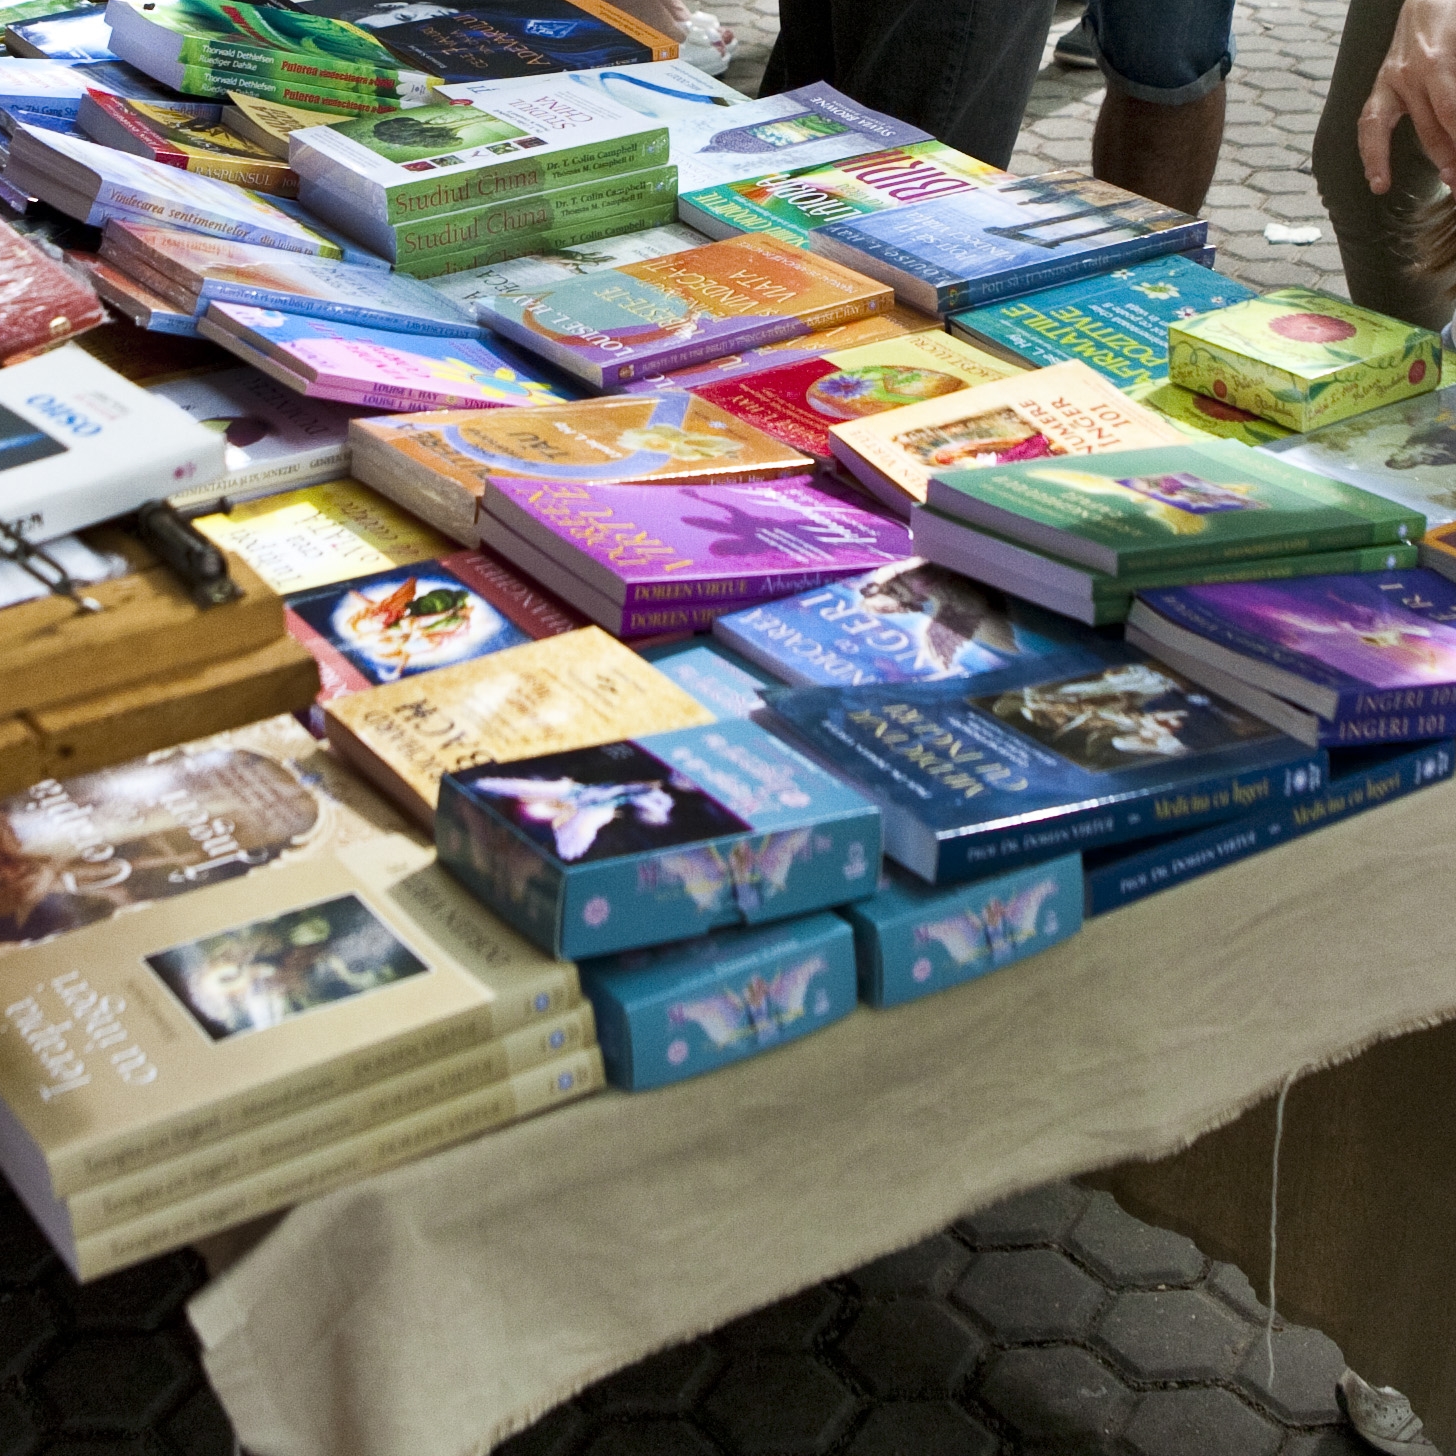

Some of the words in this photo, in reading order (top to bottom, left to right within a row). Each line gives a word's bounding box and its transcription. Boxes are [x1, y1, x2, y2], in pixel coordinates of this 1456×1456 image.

[199, 55, 231, 69] Ruediger
[232, 59, 258, 71] Dahlke
[201, 45, 235, 60] Thorwald
[236, 49, 275, 63] Dethlefsen
[280, 60, 318, 76] Puterea
[203, 73, 237, 86] Thorwald
[238, 77, 276, 92] Dethlefsen
[282, 89, 320, 104] Puterea
[40, 104, 63, 117] Gang
[507, 96, 578, 130] STUDIUL
[532, 93, 597, 123] CHINA
[809, 94, 862, 123] BROWNE
[852, 116, 897, 139] SYLVIA
[194, 165, 272, 185] RĂSPUNSUL
[395, 177, 470, 215] Studiul
[476, 169, 539, 197] China
[546, 159, 560, 171] Dr.
[562, 157, 571, 167] T.
[573, 151, 594, 165] Colin
[594, 142, 638, 162] Campbell
[551, 167, 581, 179] Thomas
[582, 165, 591, 174] M.
[591, 156, 626, 172] Campbell
[560, 205, 589, 217] Thomas
[590, 203, 600, 212] M.
[601, 193, 635, 209] Campbell
[685, 191, 785, 229] CHOQUETTE
[735, 173, 874, 223] LĂTORIA
[108, 187, 165, 215] Vindecarea
[259, 233, 276, 246] din
[403, 217, 478, 255] Studiul
[485, 206, 548, 235] China
[555, 198, 569, 210] Dr.
[570, 196, 579, 206] T.
[581, 189, 603, 204] Colin
[605, 180, 647, 198] Campbell
[580, 228, 603, 244] Colin
[604, 218, 645, 238] Campbell
[504, 292, 560, 314] HAY
[555, 319, 638, 357] LOUISE
[1001, 332, 1036, 348] Hay
[1046, 304, 1171, 369] POZITIVE
[363, 394, 395, 408] LOUISE
[407, 402, 428, 412] HAY
[373, 382, 405, 395] LOUISE
[418, 391, 439, 401] HAY
[15, 391, 114, 440] OSHO
[1003, 399, 1112, 455] NUMERE
[1081, 402, 1137, 427] 101
[634, 580, 693, 600] DOREEN
[696, 580, 746, 596] VIRTUE
[631, 608, 687, 628] DOREEN
[734, 600, 882, 688] NDECAREA
[386, 697, 499, 774] BACH
[1417, 713, 1444, 732] 101
[1071, 818, 1114, 840] VIRTUE
[1154, 793, 1211, 818] Medicina
[1212, 791, 1230, 806] cu
[1216, 831, 1256, 857] VIRTUE
[1292, 794, 1346, 824] Medicina
[1348, 788, 1364, 803] cu
